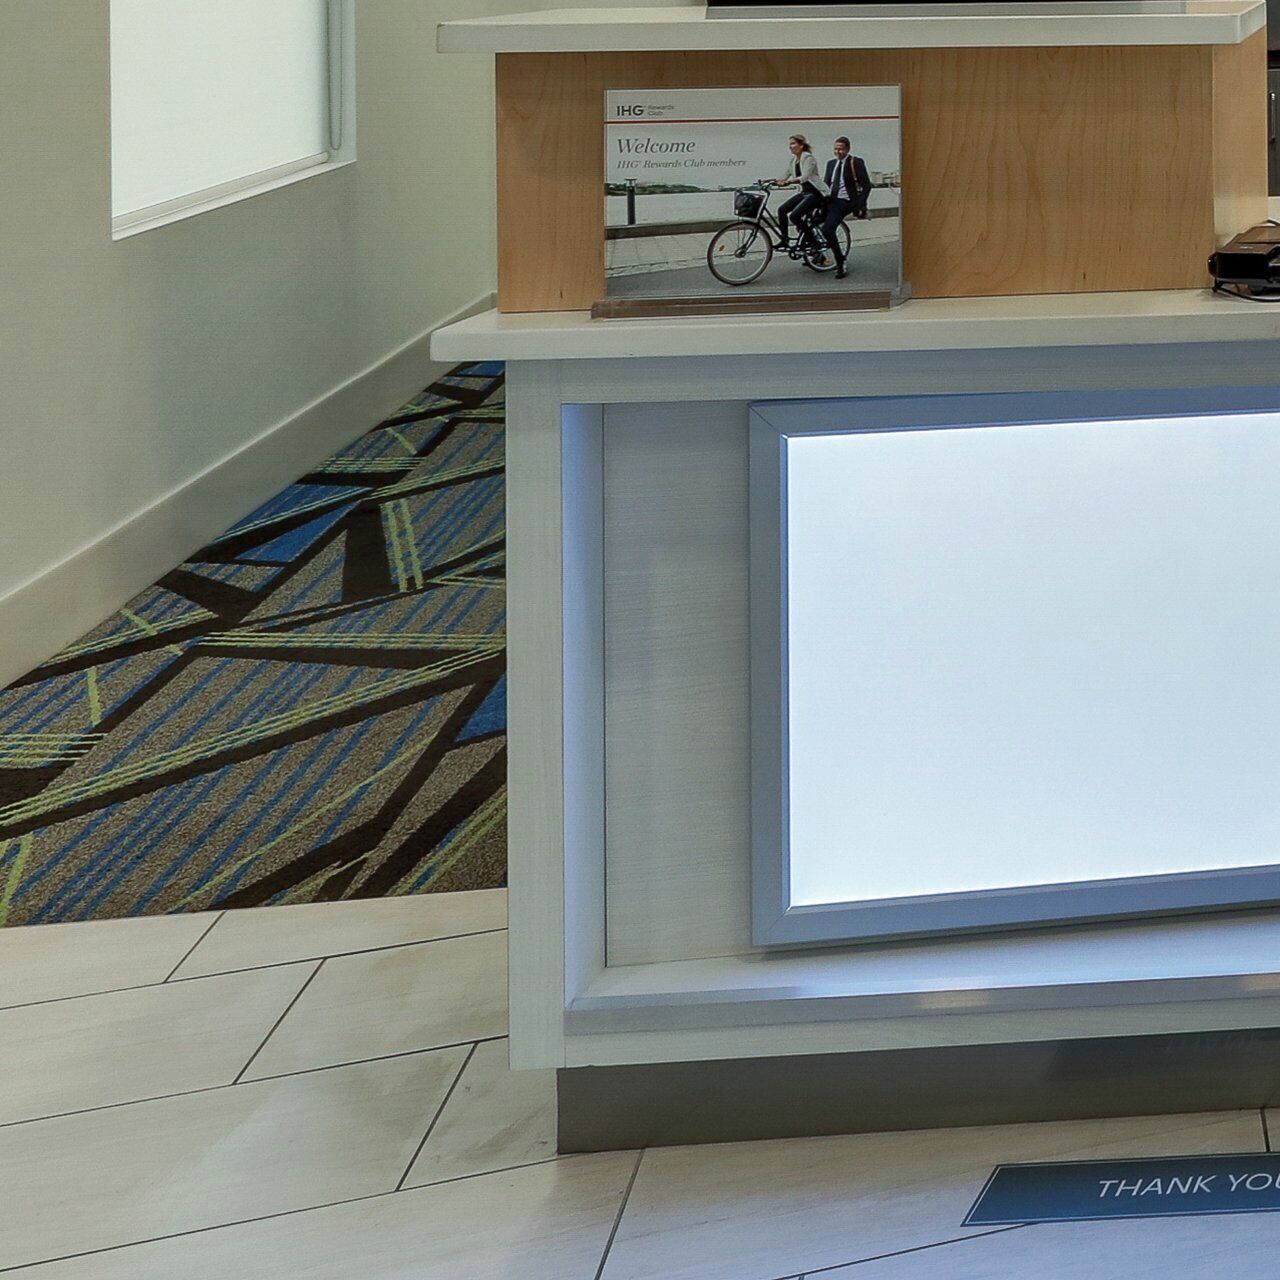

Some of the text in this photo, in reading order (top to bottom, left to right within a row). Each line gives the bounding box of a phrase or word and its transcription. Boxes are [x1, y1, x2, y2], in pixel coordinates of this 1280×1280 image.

[617, 105, 644, 117] IHG
[617, 138, 696, 154] Welcome
[644, 160, 681, 169] Rewards
[683, 159, 705, 168] Club
[707, 158, 747, 168] members
[1099, 1175, 1217, 1198] THANK
